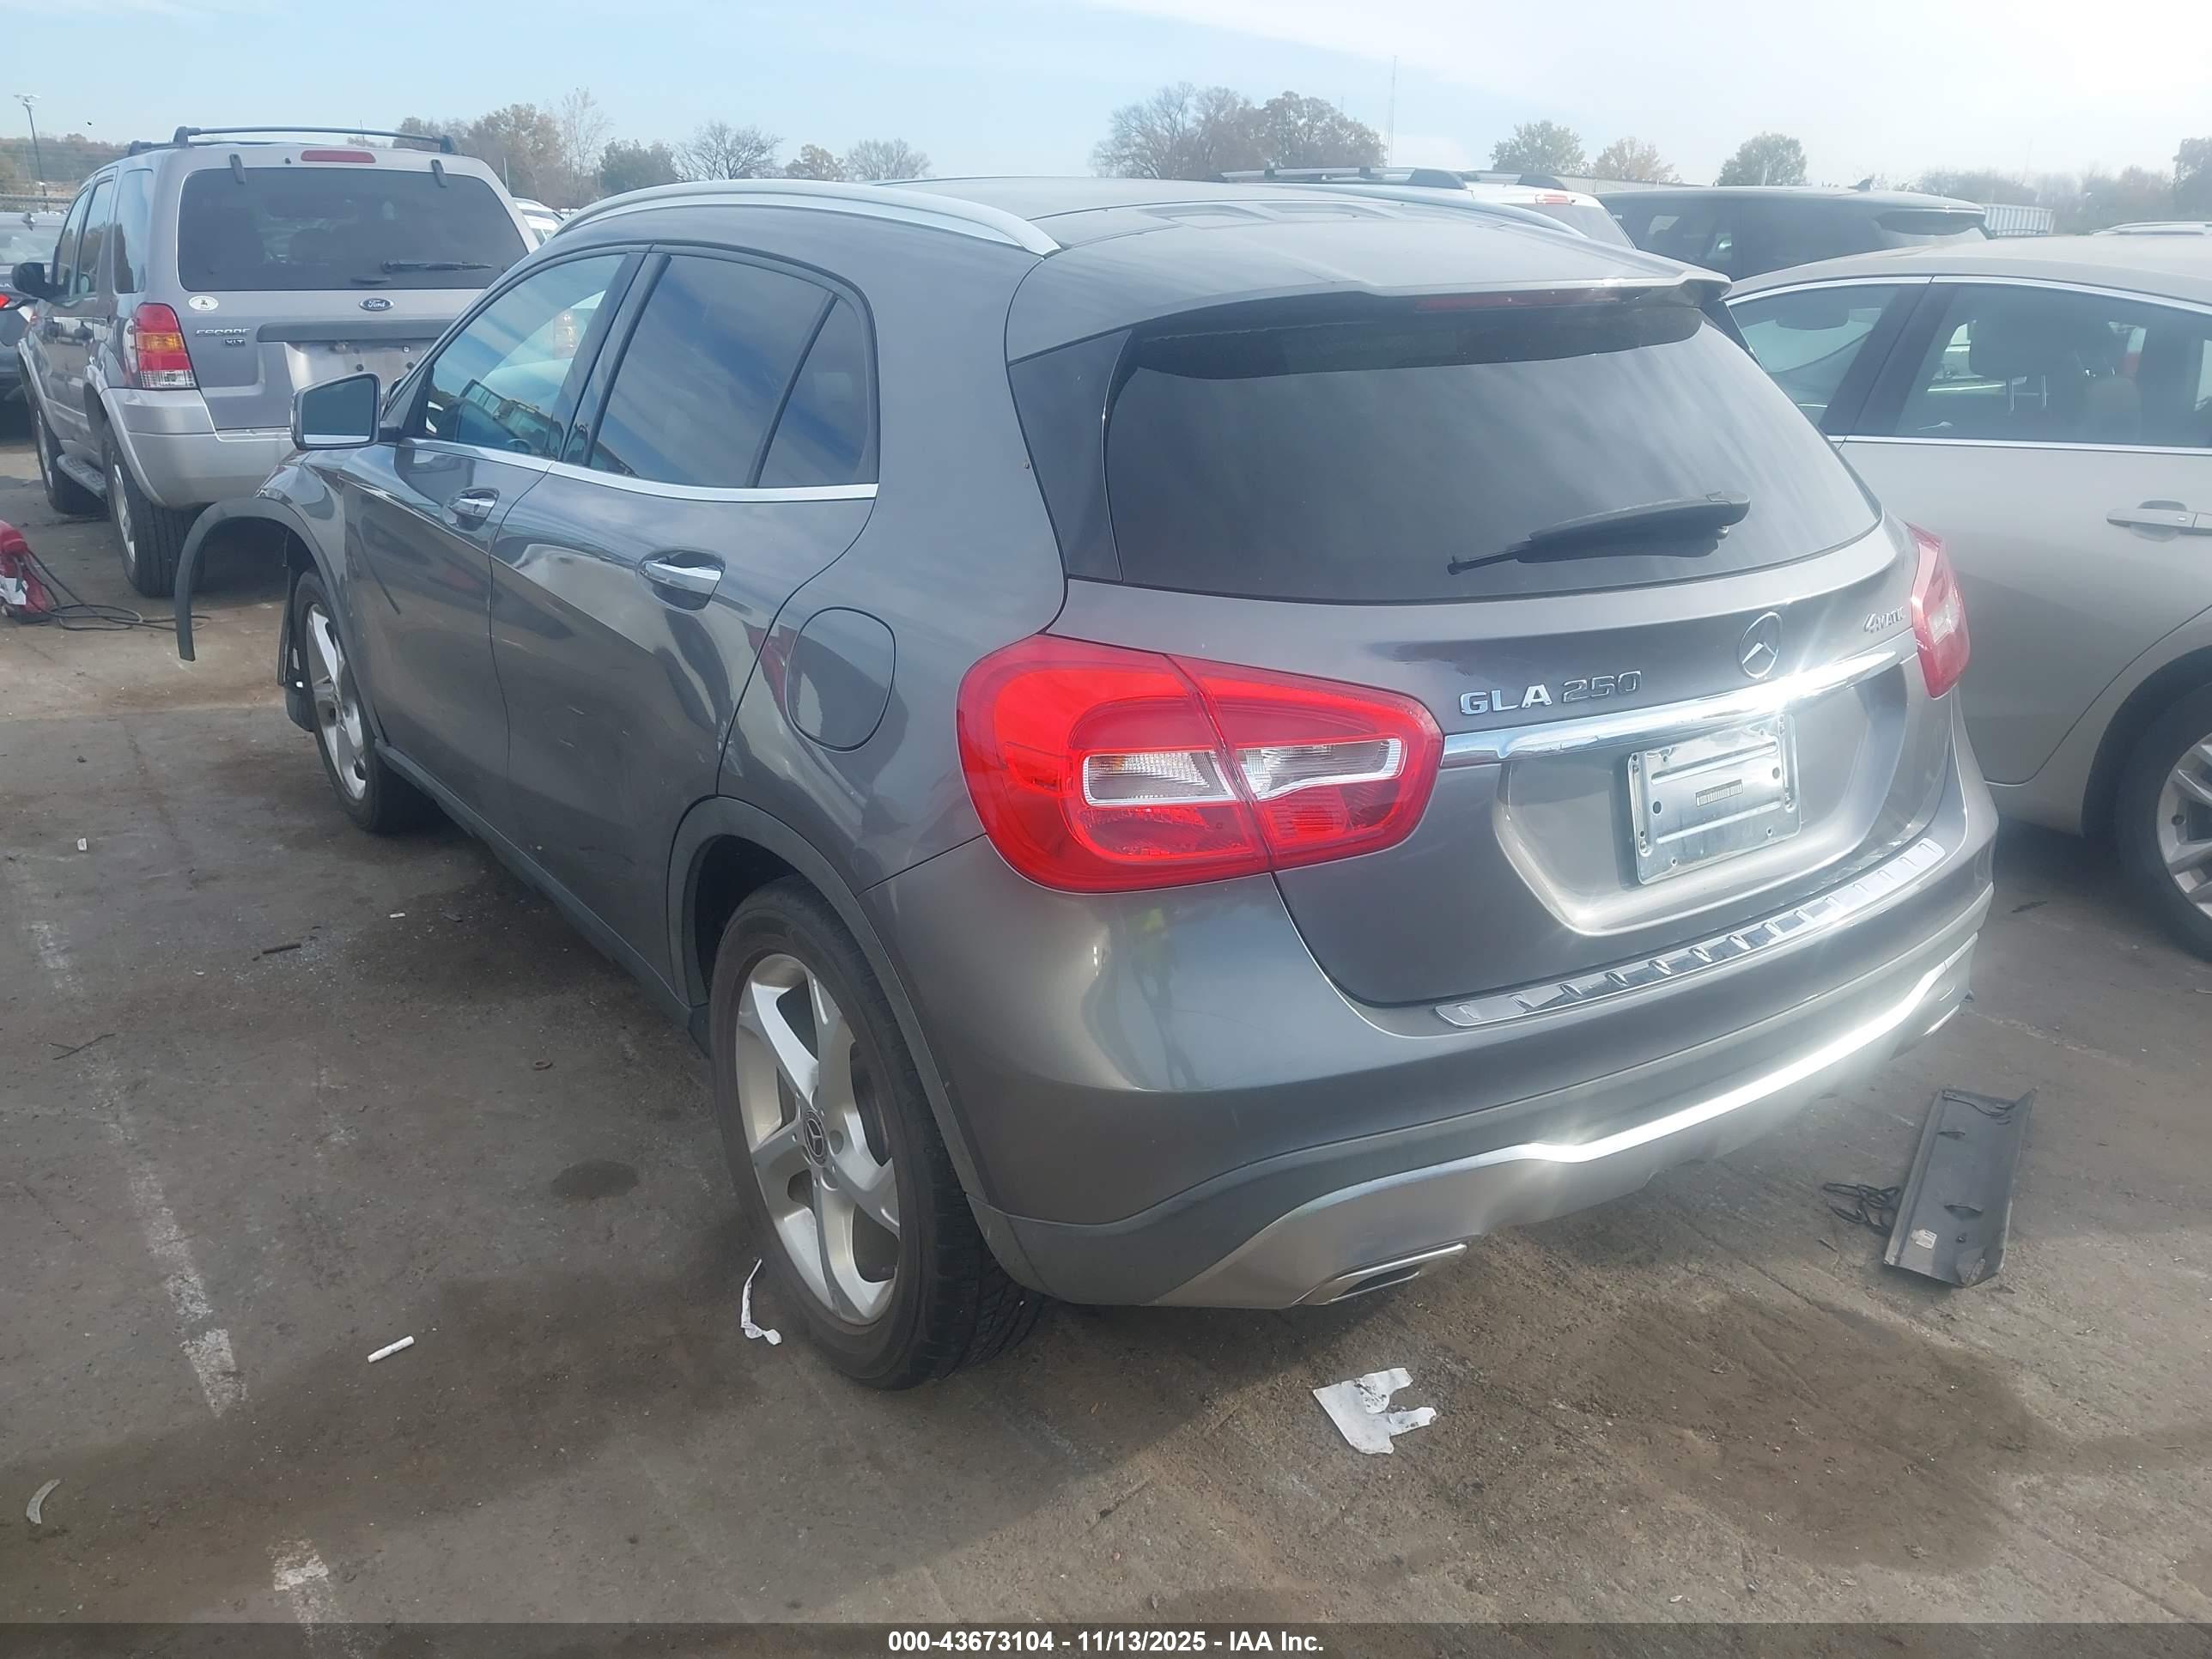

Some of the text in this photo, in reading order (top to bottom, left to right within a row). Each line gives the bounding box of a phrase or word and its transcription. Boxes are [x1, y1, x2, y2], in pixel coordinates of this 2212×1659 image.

[1863, 605, 1905, 633] 4MATIC
[1460, 670, 1642, 715] GLA 250
